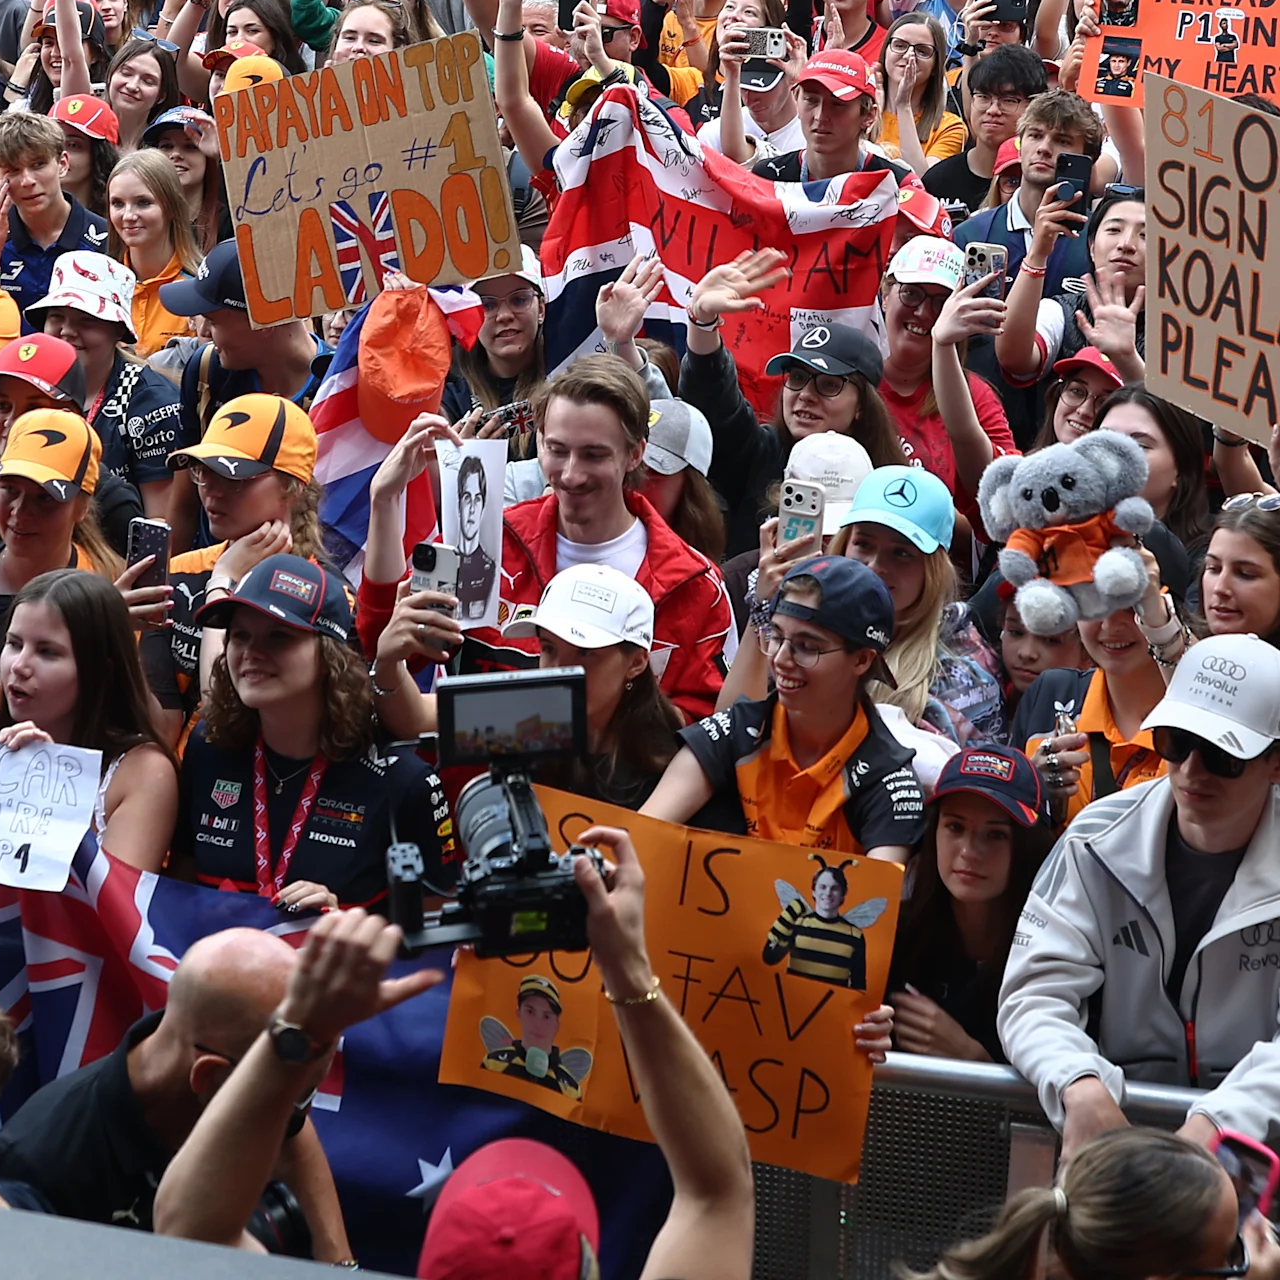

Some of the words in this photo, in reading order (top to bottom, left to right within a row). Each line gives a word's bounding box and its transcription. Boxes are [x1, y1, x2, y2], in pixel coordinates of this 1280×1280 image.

[1176, 10, 1213, 44] P1
[1242, 16, 1278, 48] IN
[815, 60, 858, 77] Santander
[1142, 54, 1181, 84] MY
[214, 68, 353, 162] PAPAYA
[352, 52, 407, 126] ON
[404, 33, 480, 111] TOP
[1160, 85, 1224, 164] 81
[236, 145, 326, 221] Let's
[337, 162, 383, 200] go
[402, 111, 487, 175] #1
[1151, 158, 1268, 262] SIGN
[236, 166, 510, 324] LANDO!
[923, 249, 965, 271] WILLIAMS
[926, 256, 960, 275] RACING
[132, 428, 175, 450] Dorto
[135, 447, 167, 460] Ventus
[278, 574, 312, 590] ORACLE
[1194, 671, 1239, 696] Revolut
[968, 755, 1010, 767] ORACLE
[212, 791, 240, 805] HEUER
[219, 781, 240, 795] TAG
[890, 790, 921, 802] ECOLAB
[317, 797, 366, 815] ORACLE
[196, 832, 234, 847] ORACLE
[308, 831, 357, 848] HONDA
[679, 839, 741, 917] IS
[668, 950, 834, 1041] FAV
